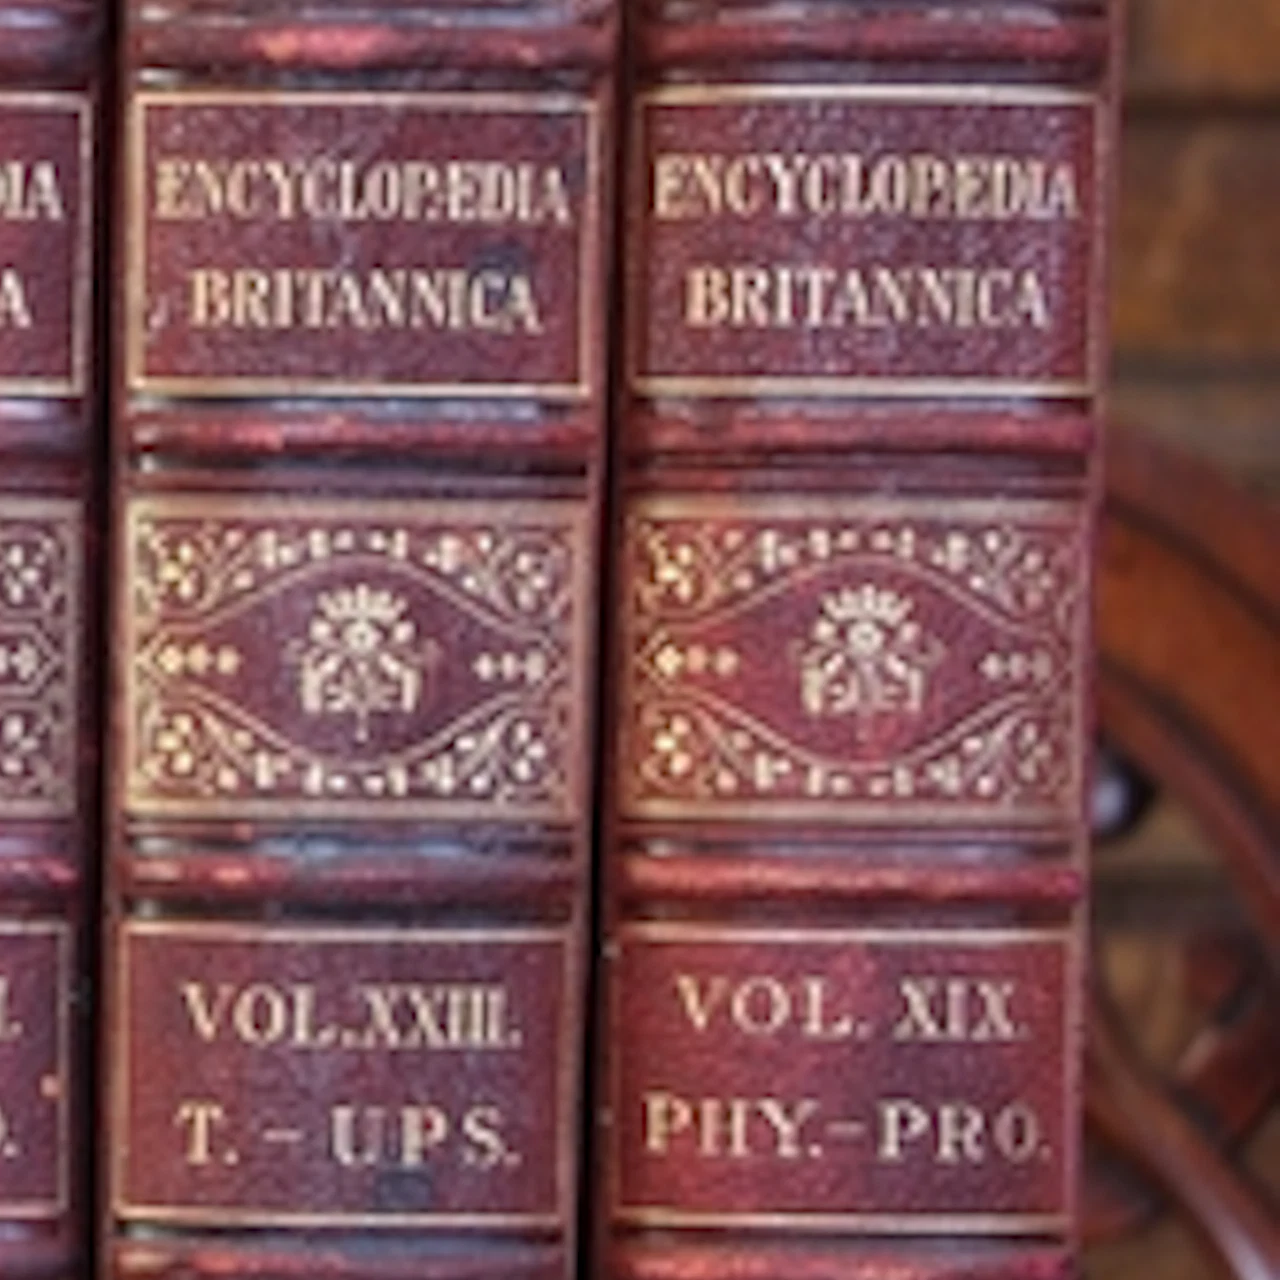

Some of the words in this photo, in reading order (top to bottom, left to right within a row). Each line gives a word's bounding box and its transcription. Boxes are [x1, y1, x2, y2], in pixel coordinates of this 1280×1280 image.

[155, 159, 572, 224] ENCYCLOPÆDIA
[652, 153, 1079, 220] ENCYCLOPÆDIA
[192, 269, 544, 333] BRITANNICA
[685, 267, 1050, 328] BRITANNICA
[676, 974, 872, 1039] VOL.
